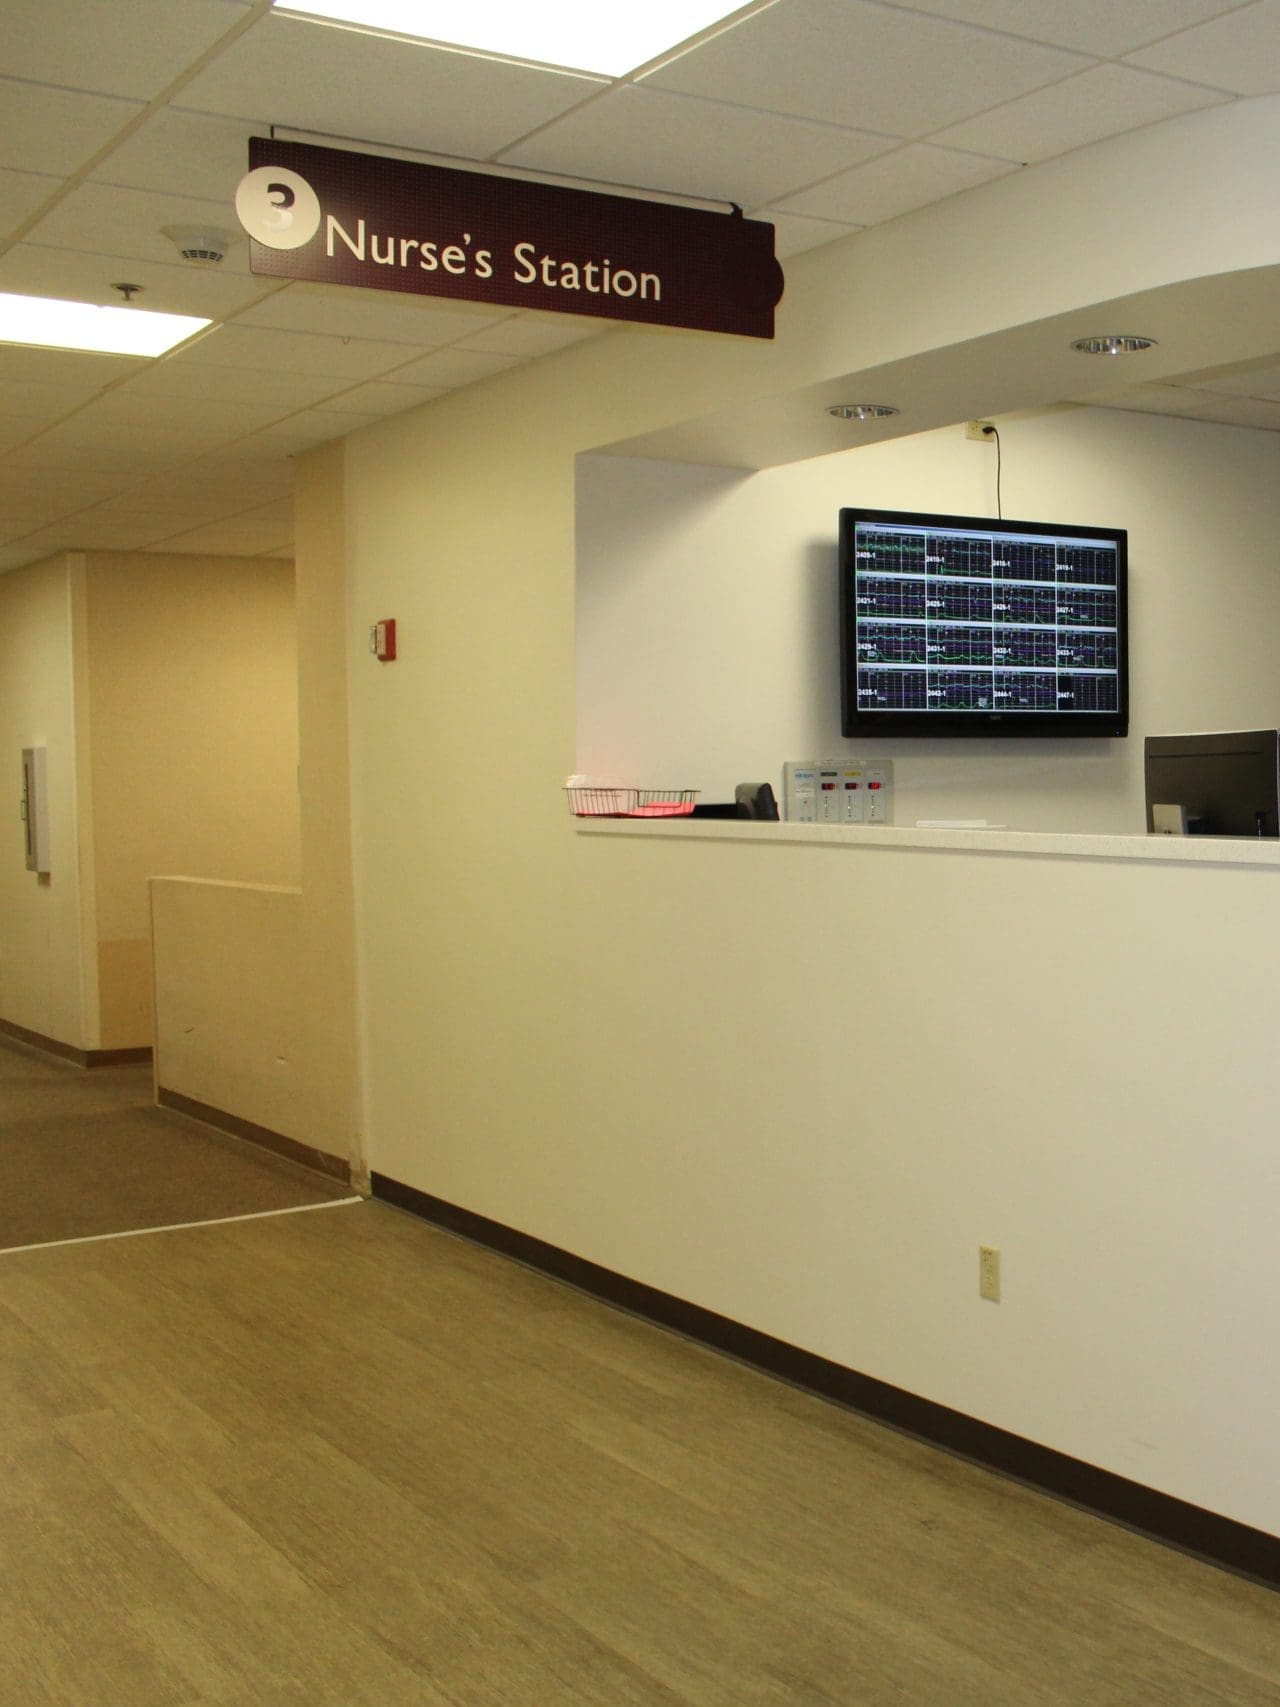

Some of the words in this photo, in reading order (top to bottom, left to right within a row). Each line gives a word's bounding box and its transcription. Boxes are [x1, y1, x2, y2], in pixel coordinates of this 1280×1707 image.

[262, 182, 296, 233] 3
[325, 213, 494, 279] Nurse's
[513, 242, 662, 301] Station
